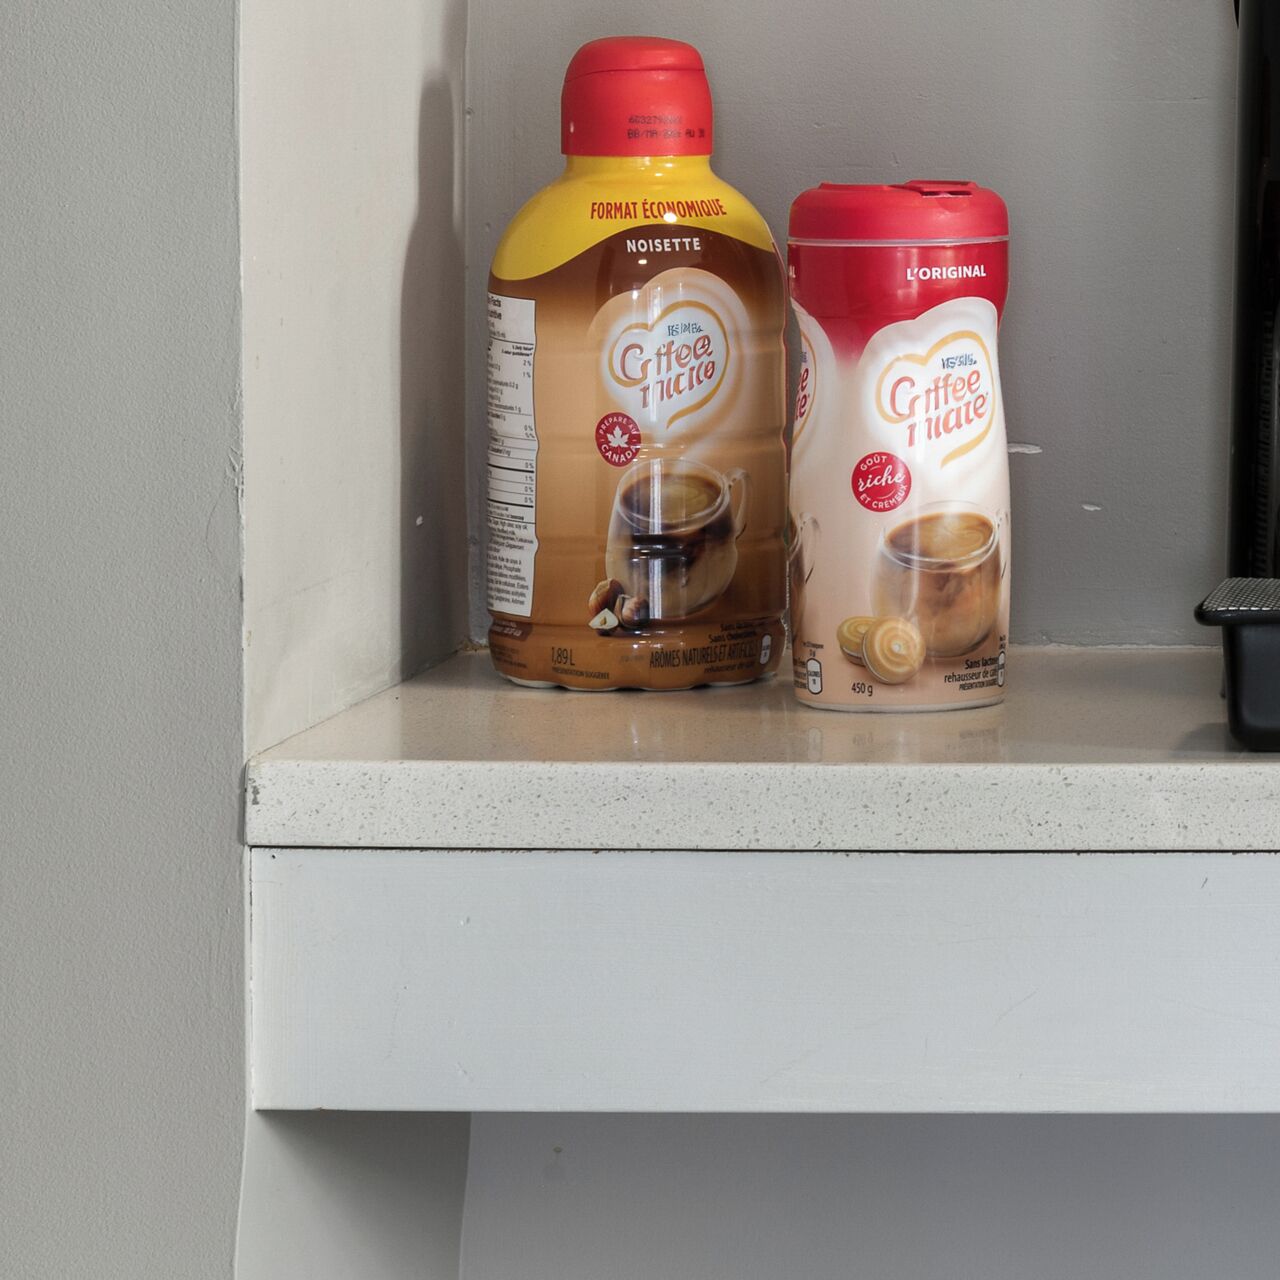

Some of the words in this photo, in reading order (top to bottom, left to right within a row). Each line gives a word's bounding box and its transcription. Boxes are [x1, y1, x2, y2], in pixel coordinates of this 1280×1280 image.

[590, 201, 637, 220] FORMAT
[642, 198, 727, 220] ÉCONOMIQUE
[626, 237, 701, 253] NOISETTE
[906, 264, 986, 281] L'ORIGINAL
[601, 444, 637, 463] CANADA
[860, 454, 887, 471] GOÛT
[858, 464, 906, 491] riche
[860, 493, 871, 503] ET
[551, 646, 569, 665] 1,89
[650, 648, 681, 668] ARÔMES
[682, 644, 717, 666] NATURELS
[964, 658, 982, 669] Sans
[944, 671, 981, 683] rehausseur
[851, 682, 866, 694] 450
[867, 684, 873, 696] g
